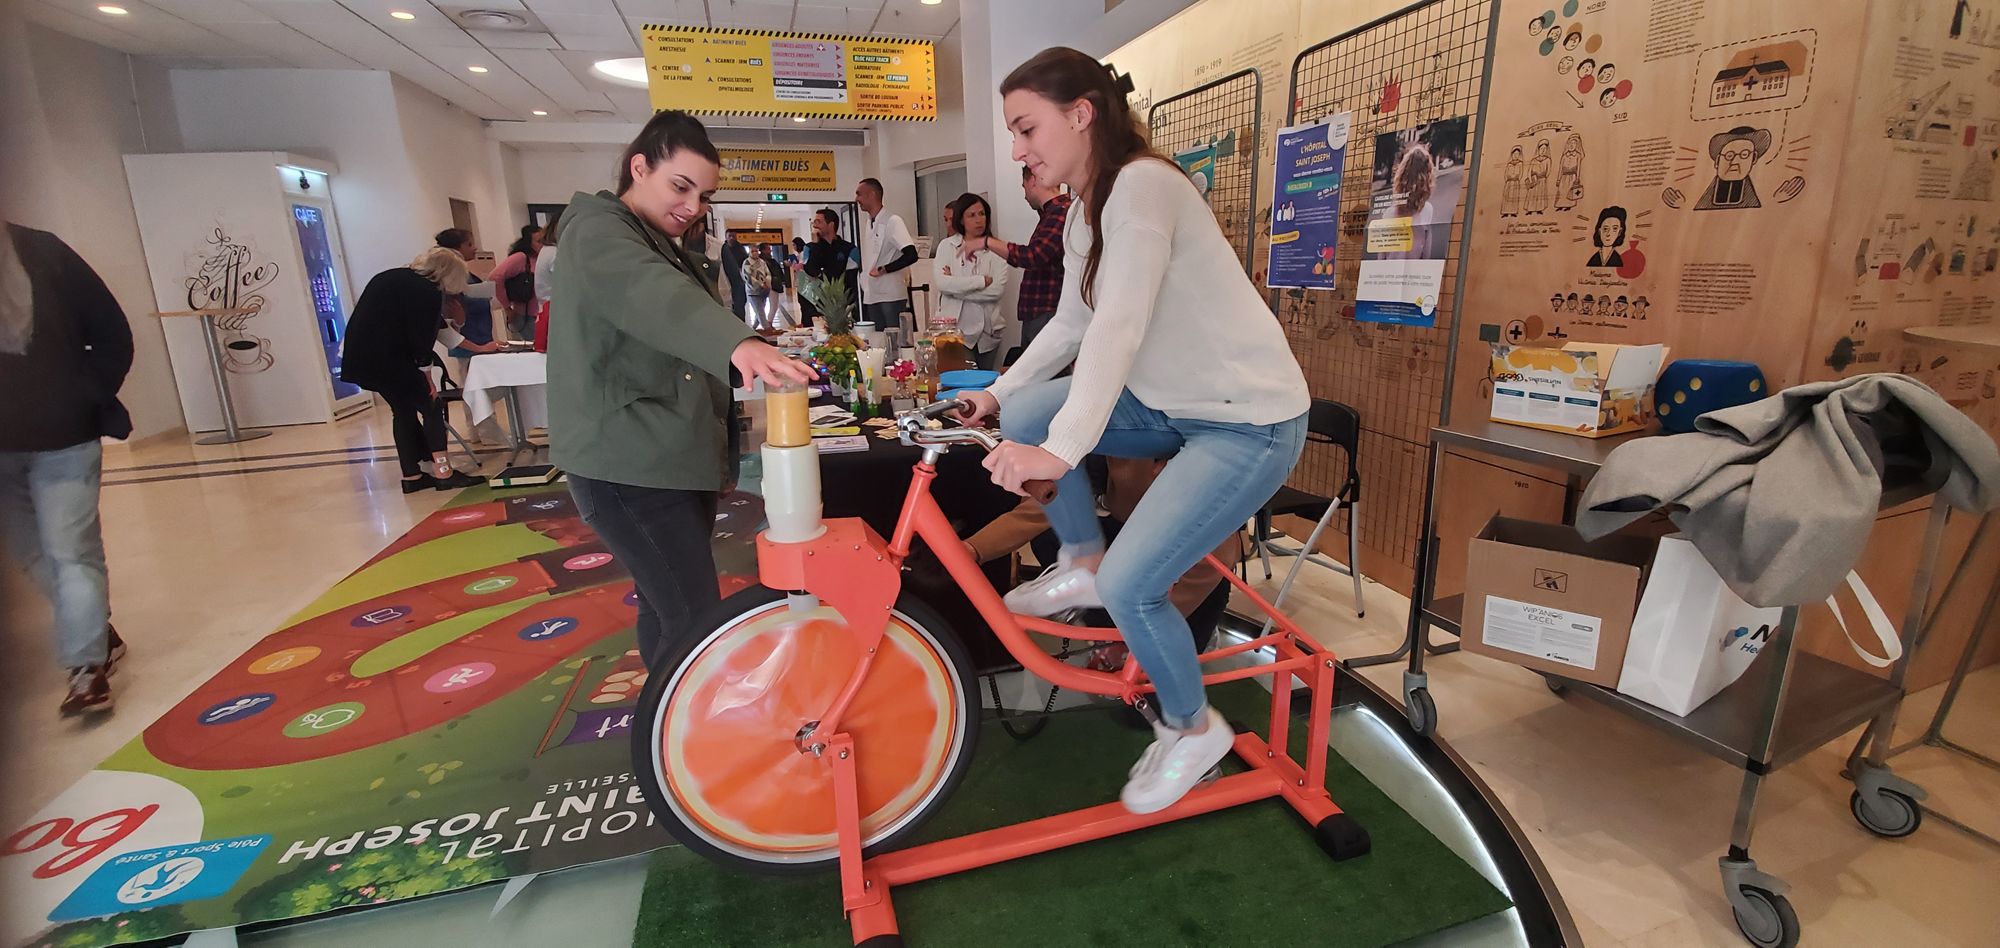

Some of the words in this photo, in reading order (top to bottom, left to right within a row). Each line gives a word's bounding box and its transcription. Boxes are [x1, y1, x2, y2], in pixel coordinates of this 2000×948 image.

[1300, 141, 1328, 154] L'HÔPITAL
[728, 156, 780, 171] BÂTIMENT
[1295, 156, 1311, 167] SAINT
[1311, 152, 1331, 166] JOSEPH
[186, 246, 272, 311] Coffee
[1527, 613, 1556, 626] EXCEL
[595, 715, 635, 739] rt
[184, 841, 222, 856] Sport
[227, 837, 263, 850] Pôle
[115, 850, 160, 866] Santé
[163, 848, 176, 859] &
